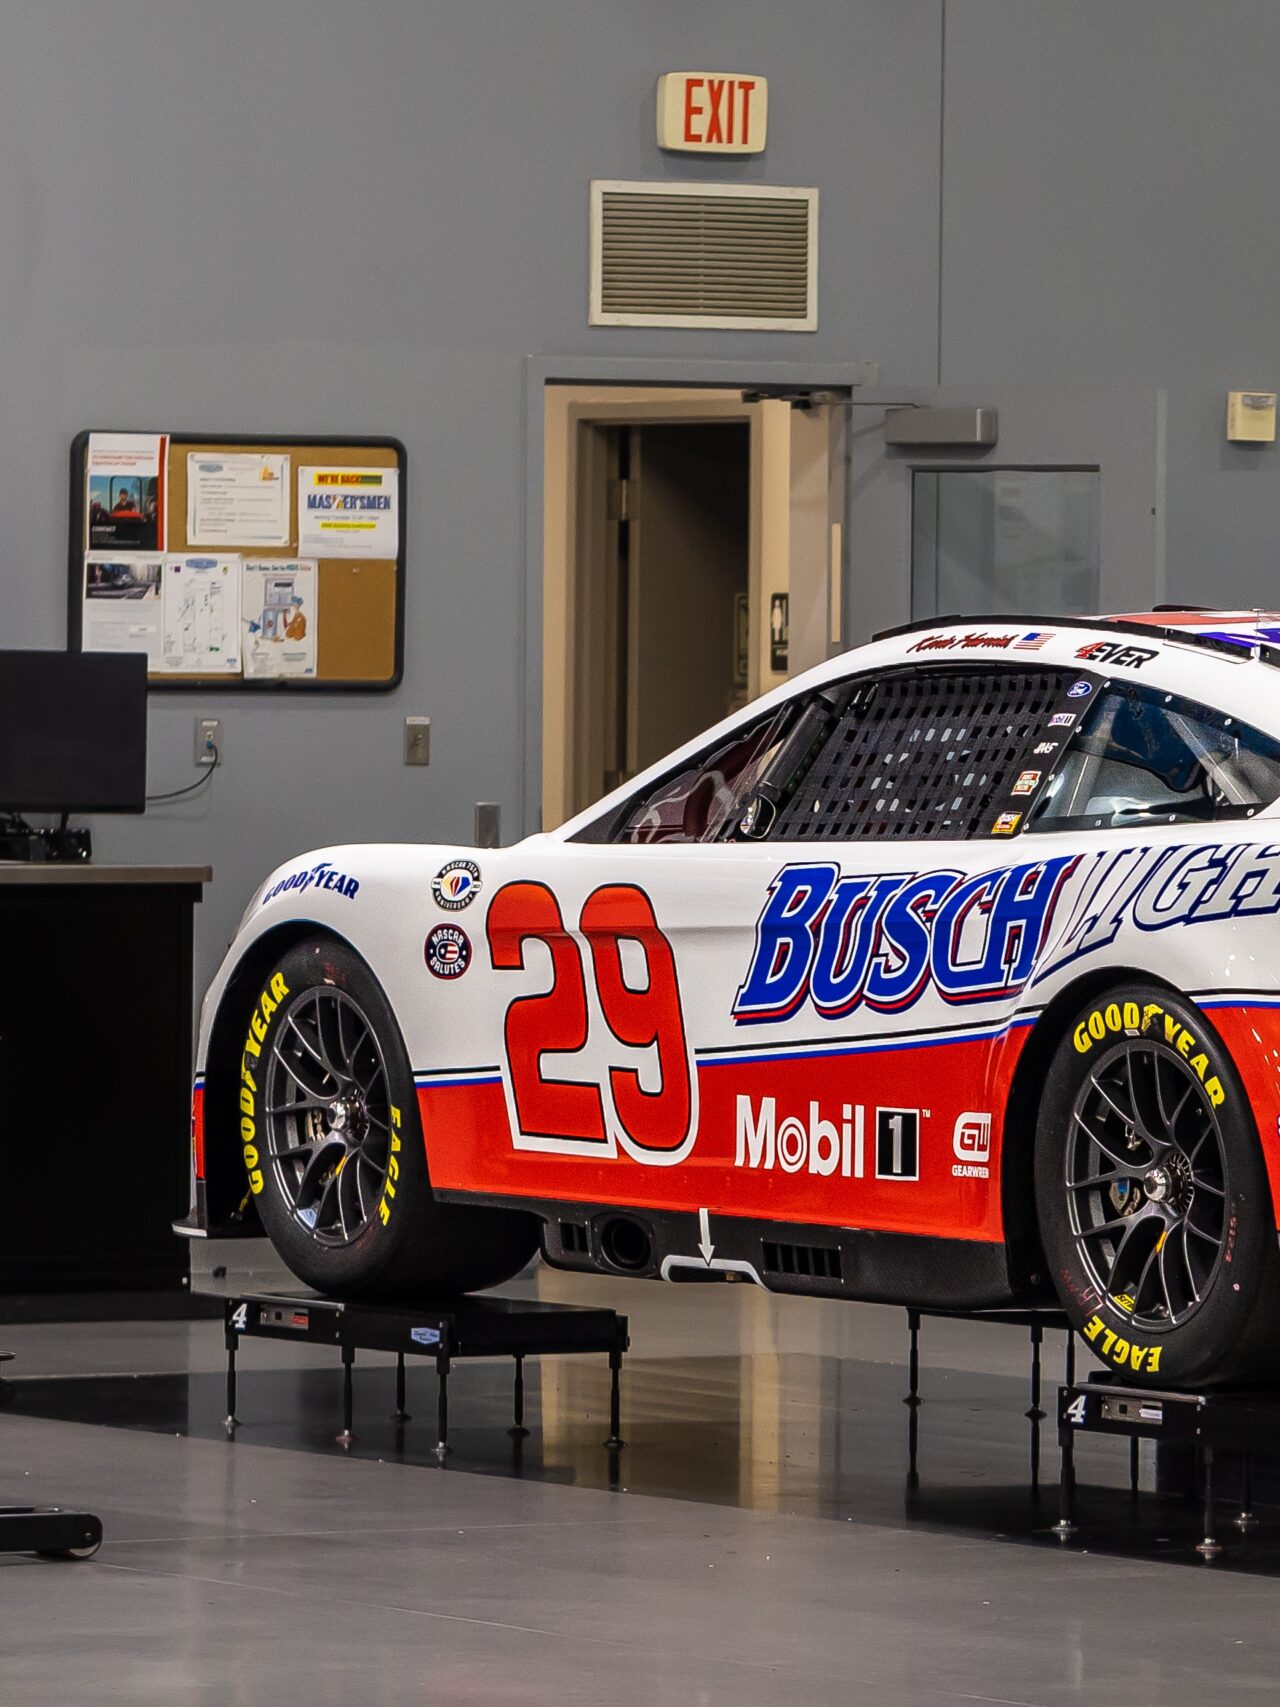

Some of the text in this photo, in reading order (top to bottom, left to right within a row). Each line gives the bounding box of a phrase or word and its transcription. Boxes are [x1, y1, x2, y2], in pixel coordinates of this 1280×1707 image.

[684, 79, 755, 144] EXIT
[1075, 641, 1159, 669] 4EVER
[262, 863, 360, 905] GOODYEAR
[430, 957, 466, 974] SALUTES
[431, 928, 465, 947] NASCAR
[731, 857, 1084, 1025] BUSCH
[486, 880, 698, 1160] 29
[240, 971, 290, 1195] GOODYEAR
[1073, 1002, 1226, 1109] GOODYEAR
[378, 1104, 402, 1227] EAGLE
[734, 1094, 903, 1178] Mobil 1
[232, 1302, 248, 1330] 4
[1083, 1315, 1162, 1373] EAGLE
[1066, 1395, 1087, 1423] 4
